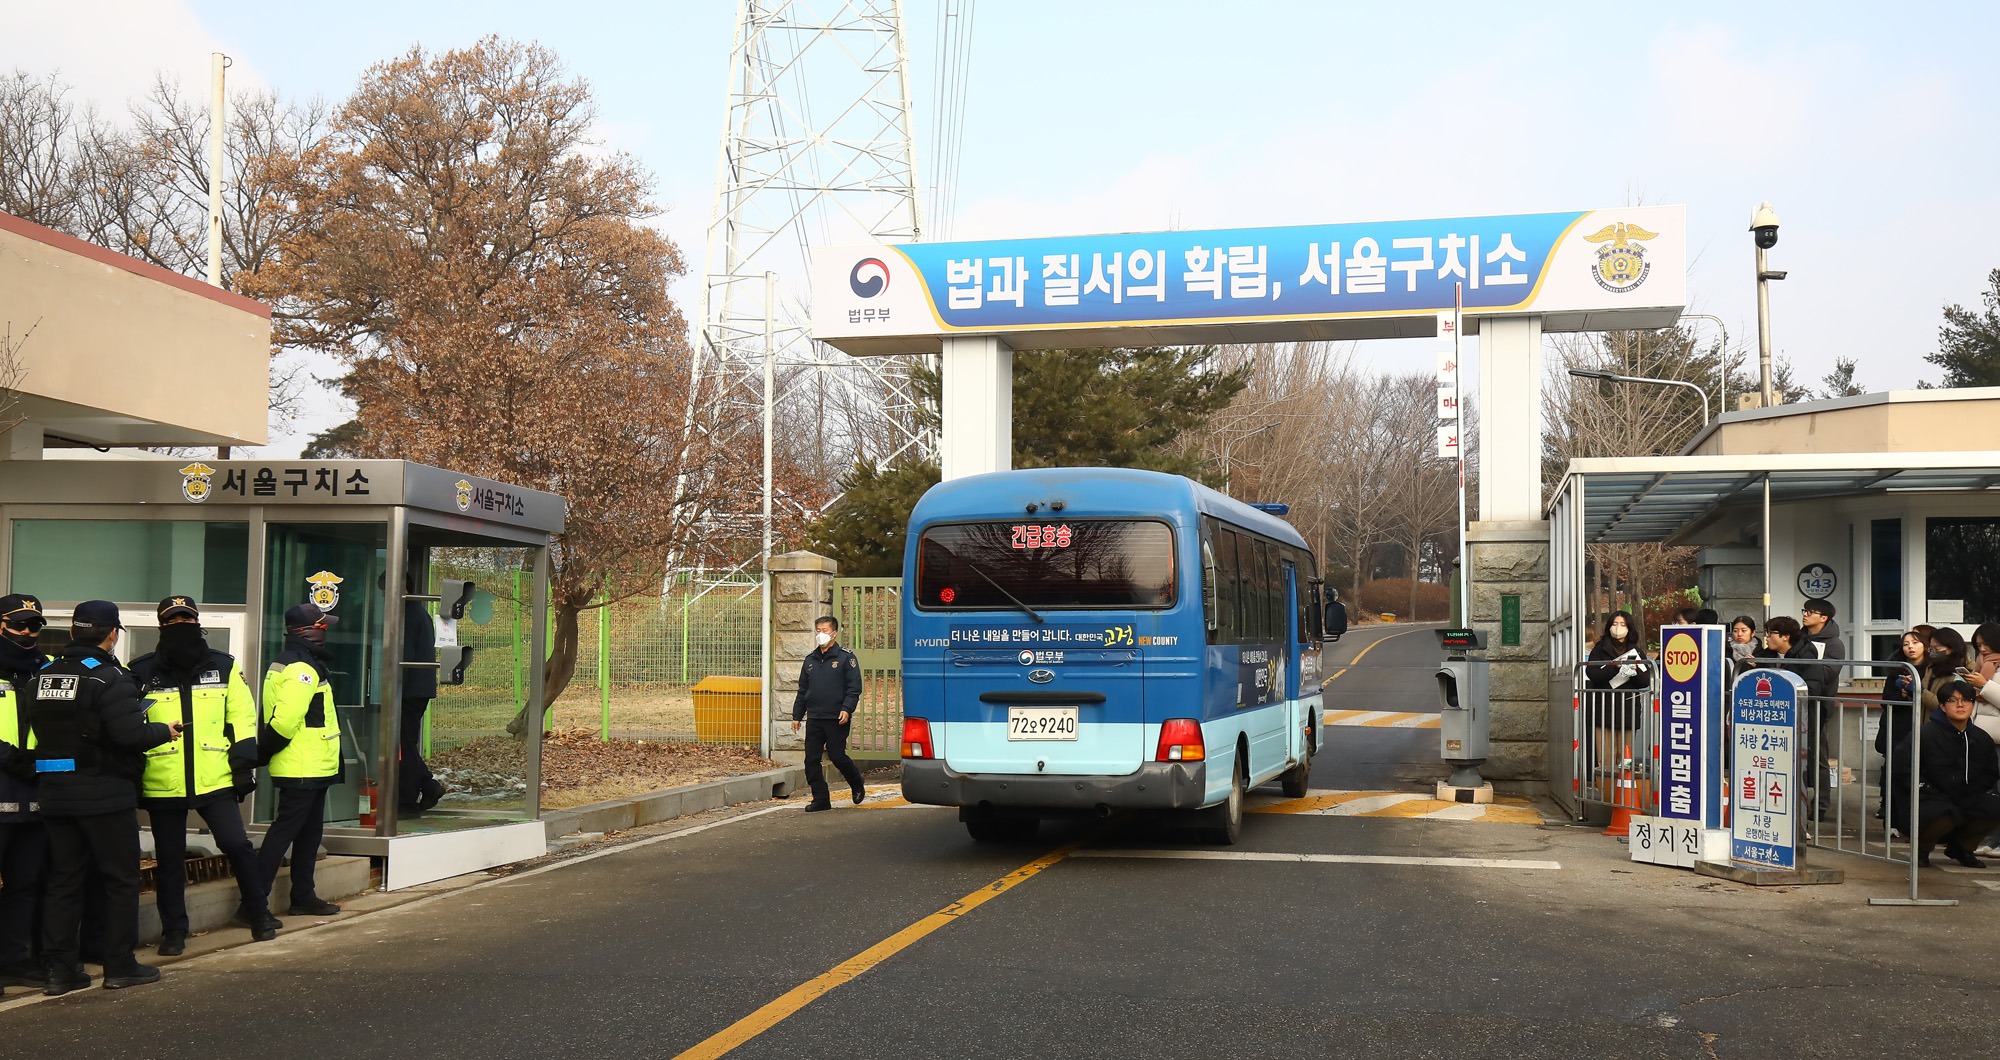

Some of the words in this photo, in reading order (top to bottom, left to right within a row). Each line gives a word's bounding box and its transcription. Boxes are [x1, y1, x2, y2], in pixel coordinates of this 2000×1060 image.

[947, 256, 1029, 310] 법과
[1042, 248, 1166, 307] 질서의
[1183, 245, 1282, 301] 확립,
[1299, 233, 1528, 295] 서울구치소
[849, 308, 891, 323] 법무부
[222, 467, 370, 496] 서울구치소
[473, 487, 524, 516] 서울구치소
[1012, 524, 1072, 548] 긴급호송
[1803, 578, 1832, 589] 143
[951, 629, 960, 641] 더
[962, 629, 980, 641] 나은
[983, 629, 1010, 642] 내일을
[1012, 629, 1039, 641] 만들어
[1042, 629, 1072, 642] 갑니다.
[1075, 633, 1104, 642] 대한민국
[1103, 624, 1134, 647] 교정
[1138, 636, 1151, 646] NEW
[1152, 636, 1178, 646] COUNTY
[1035, 651, 1064, 660] 법무부
[1666, 650, 1697, 665] STOP
[43, 678, 74, 689] 경찰
[1738, 698, 1753, 708] 수도권
[1754, 699, 1769, 708] 고농도
[1770, 700, 1790, 709] 미세먼지
[1741, 708, 1787, 723] 비상저감조치
[1011, 717, 1074, 733] 72오9240
[1740, 734, 1758, 749] 차량
[1761, 733, 1788, 752] 2부제
[1670, 691, 1693, 814] 일단멈춤
[1752, 755, 1775, 770] 오늘은
[1752, 814, 1772, 828] 차량
[1636, 823, 1699, 854] 정지선
[1745, 827, 1770, 841] 운행하는
[1772, 831, 1779, 842] 날
[1744, 845, 1780, 861] 서울구치소
